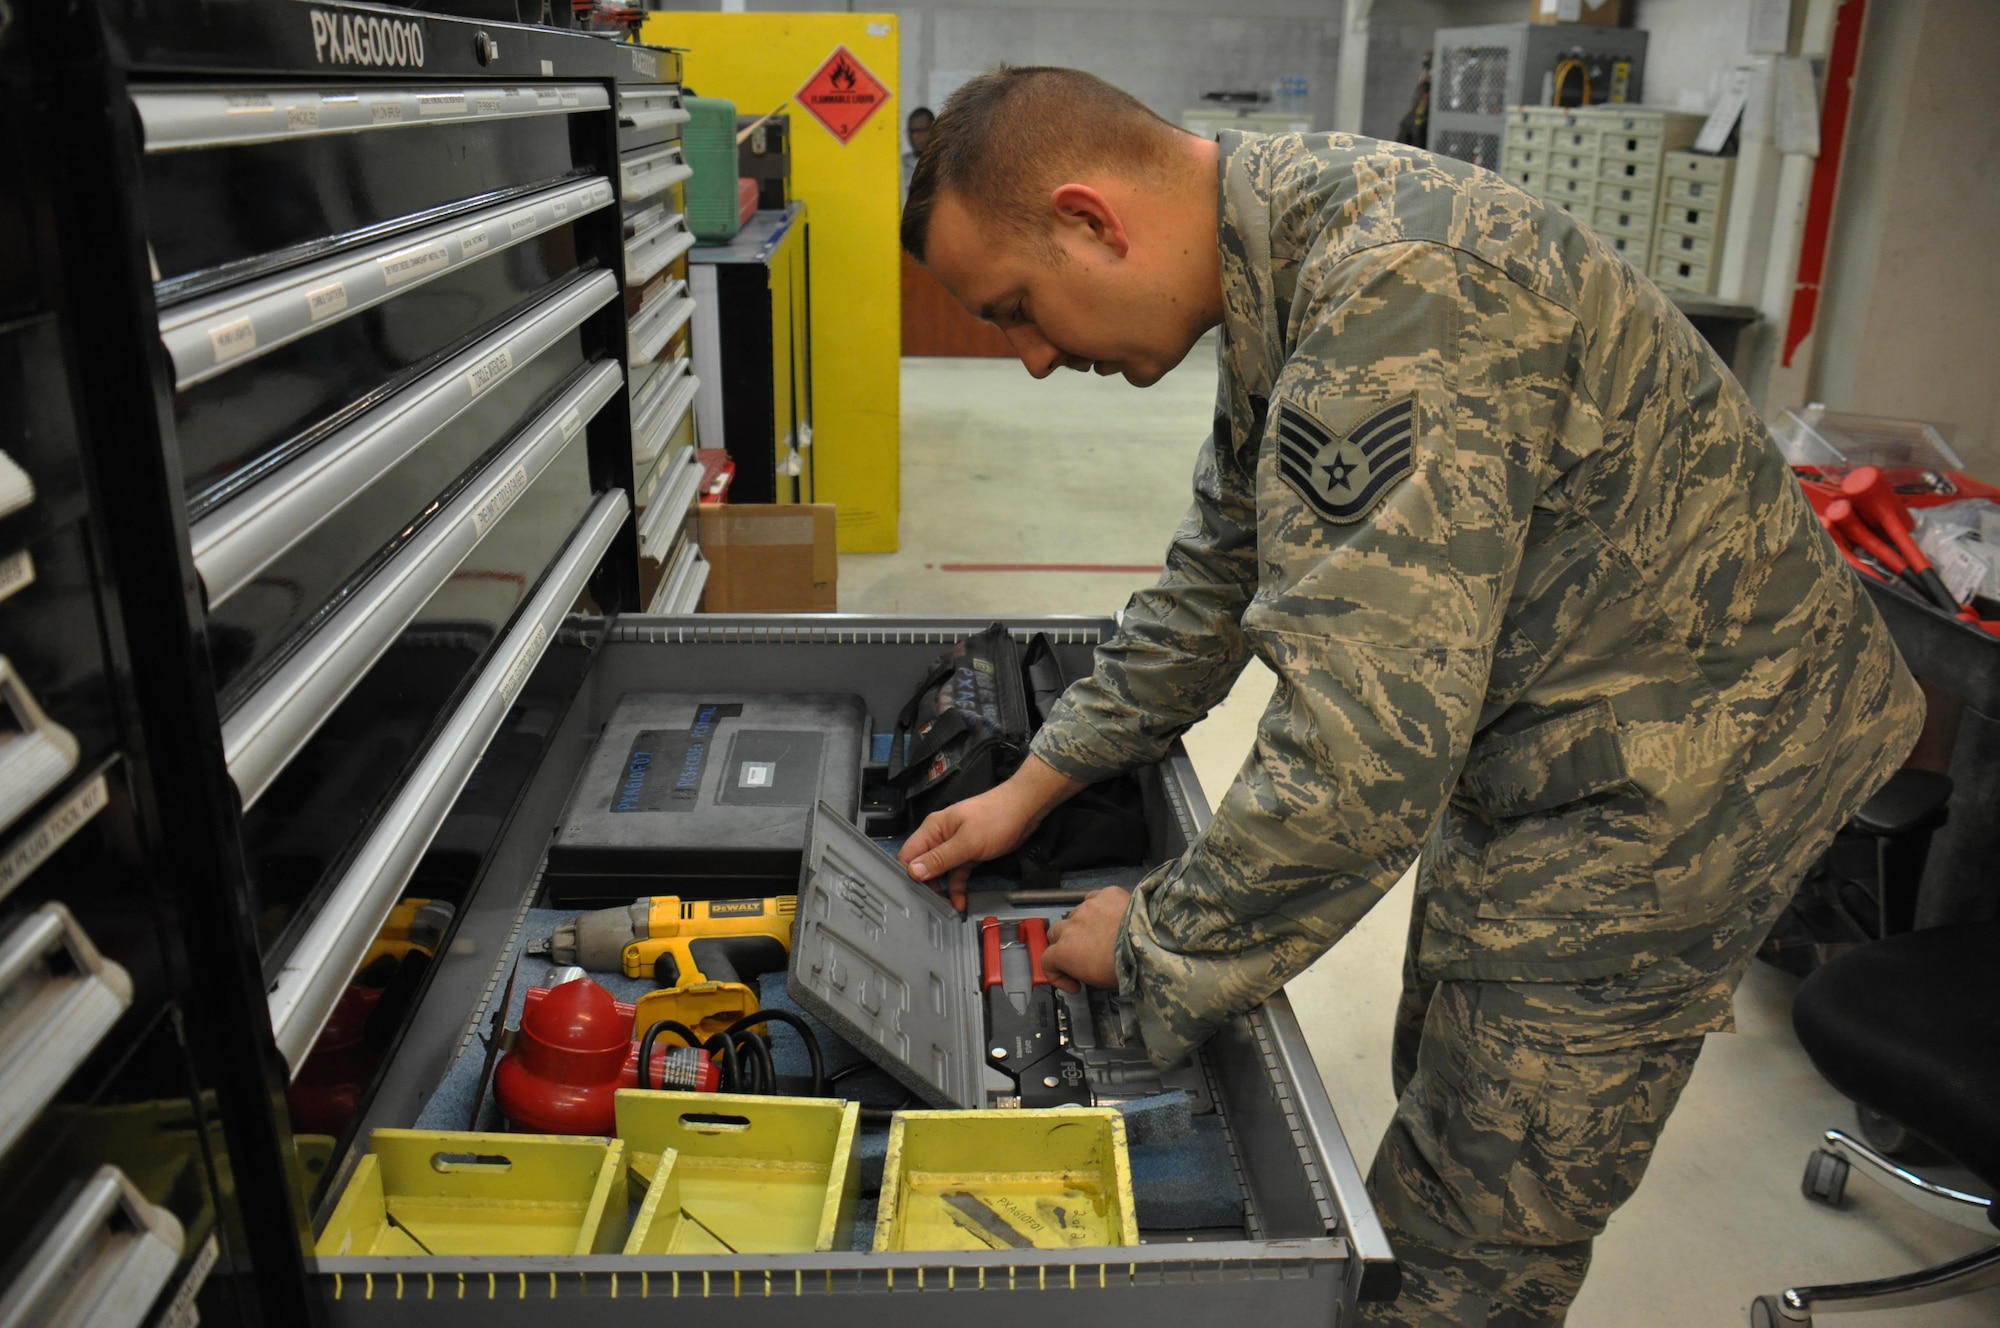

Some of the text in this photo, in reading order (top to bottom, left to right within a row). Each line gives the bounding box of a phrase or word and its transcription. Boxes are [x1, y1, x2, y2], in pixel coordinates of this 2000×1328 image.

[310, 9, 424, 68] PXAG00010
[811, 94, 875, 104] FLAMMABLE LIQUID
[840, 124, 848, 134] 3
[471, 353, 508, 388] TORQUE WRENCHES
